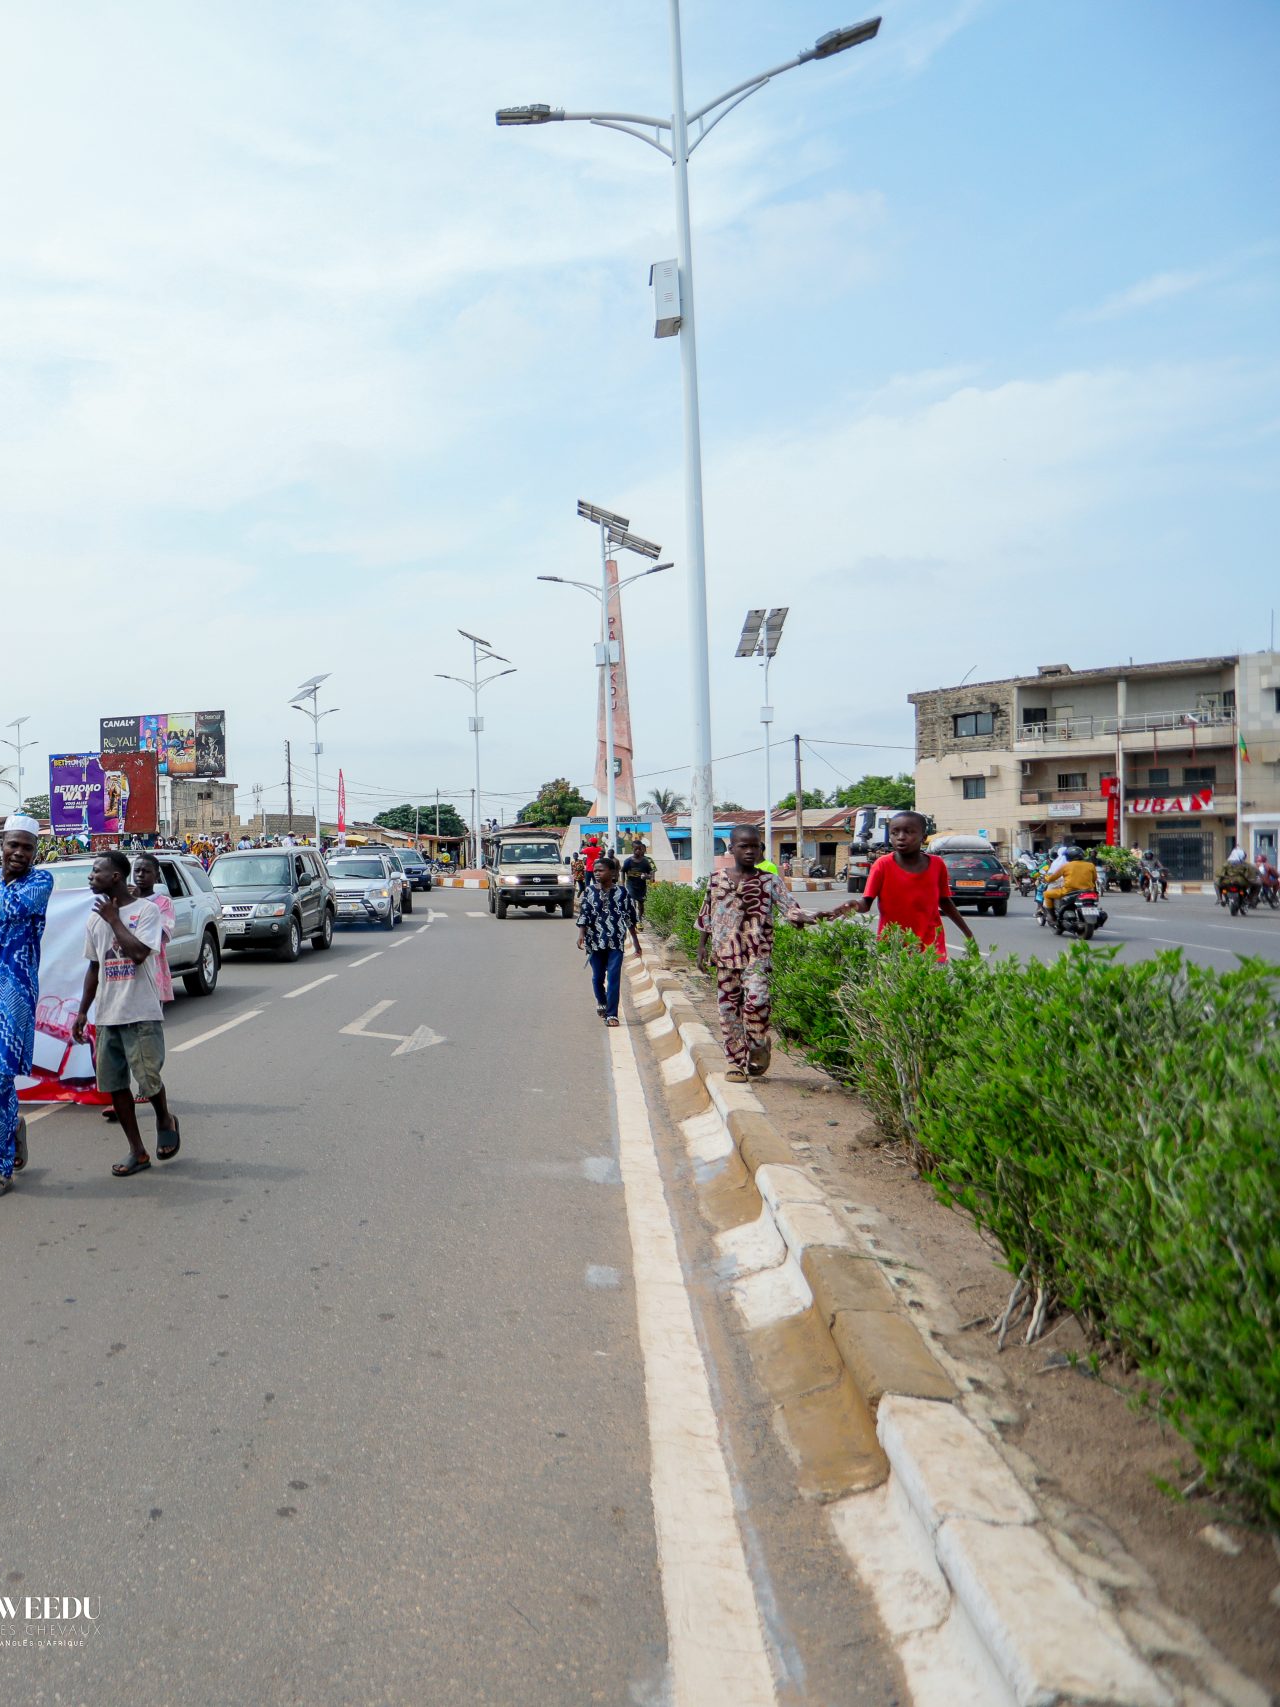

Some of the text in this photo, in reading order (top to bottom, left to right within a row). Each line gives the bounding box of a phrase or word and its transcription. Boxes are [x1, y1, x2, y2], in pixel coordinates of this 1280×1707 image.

[103, 720, 135, 728] CANAL+
[103, 736, 137, 748] ROYAL!
[54, 784, 101, 793] BETMOMO
[63, 792, 82, 801] WA
[1133, 797, 1185, 813] UBA
